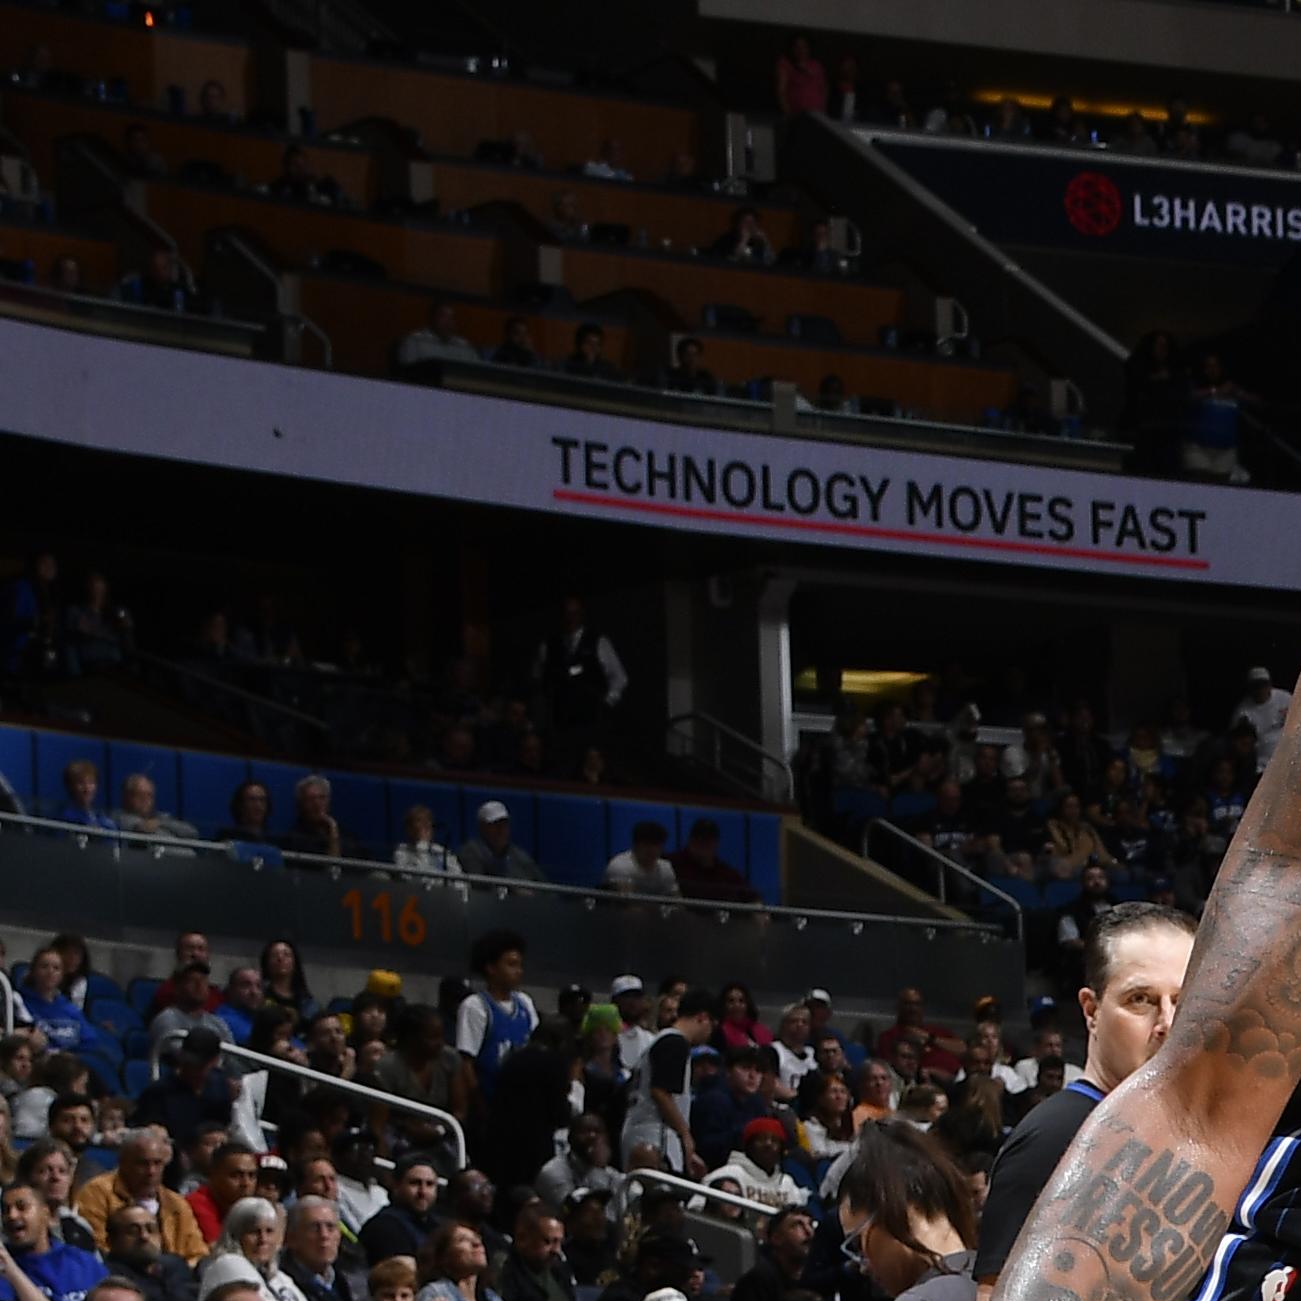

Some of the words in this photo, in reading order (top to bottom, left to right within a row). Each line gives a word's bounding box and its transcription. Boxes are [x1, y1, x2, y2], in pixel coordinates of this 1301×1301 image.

[552, 437, 889, 522] TECHNOLOGY
[907, 481, 1074, 544] MOVES
[1091, 500, 1208, 554] FAST
[341, 889, 428, 947] 116
